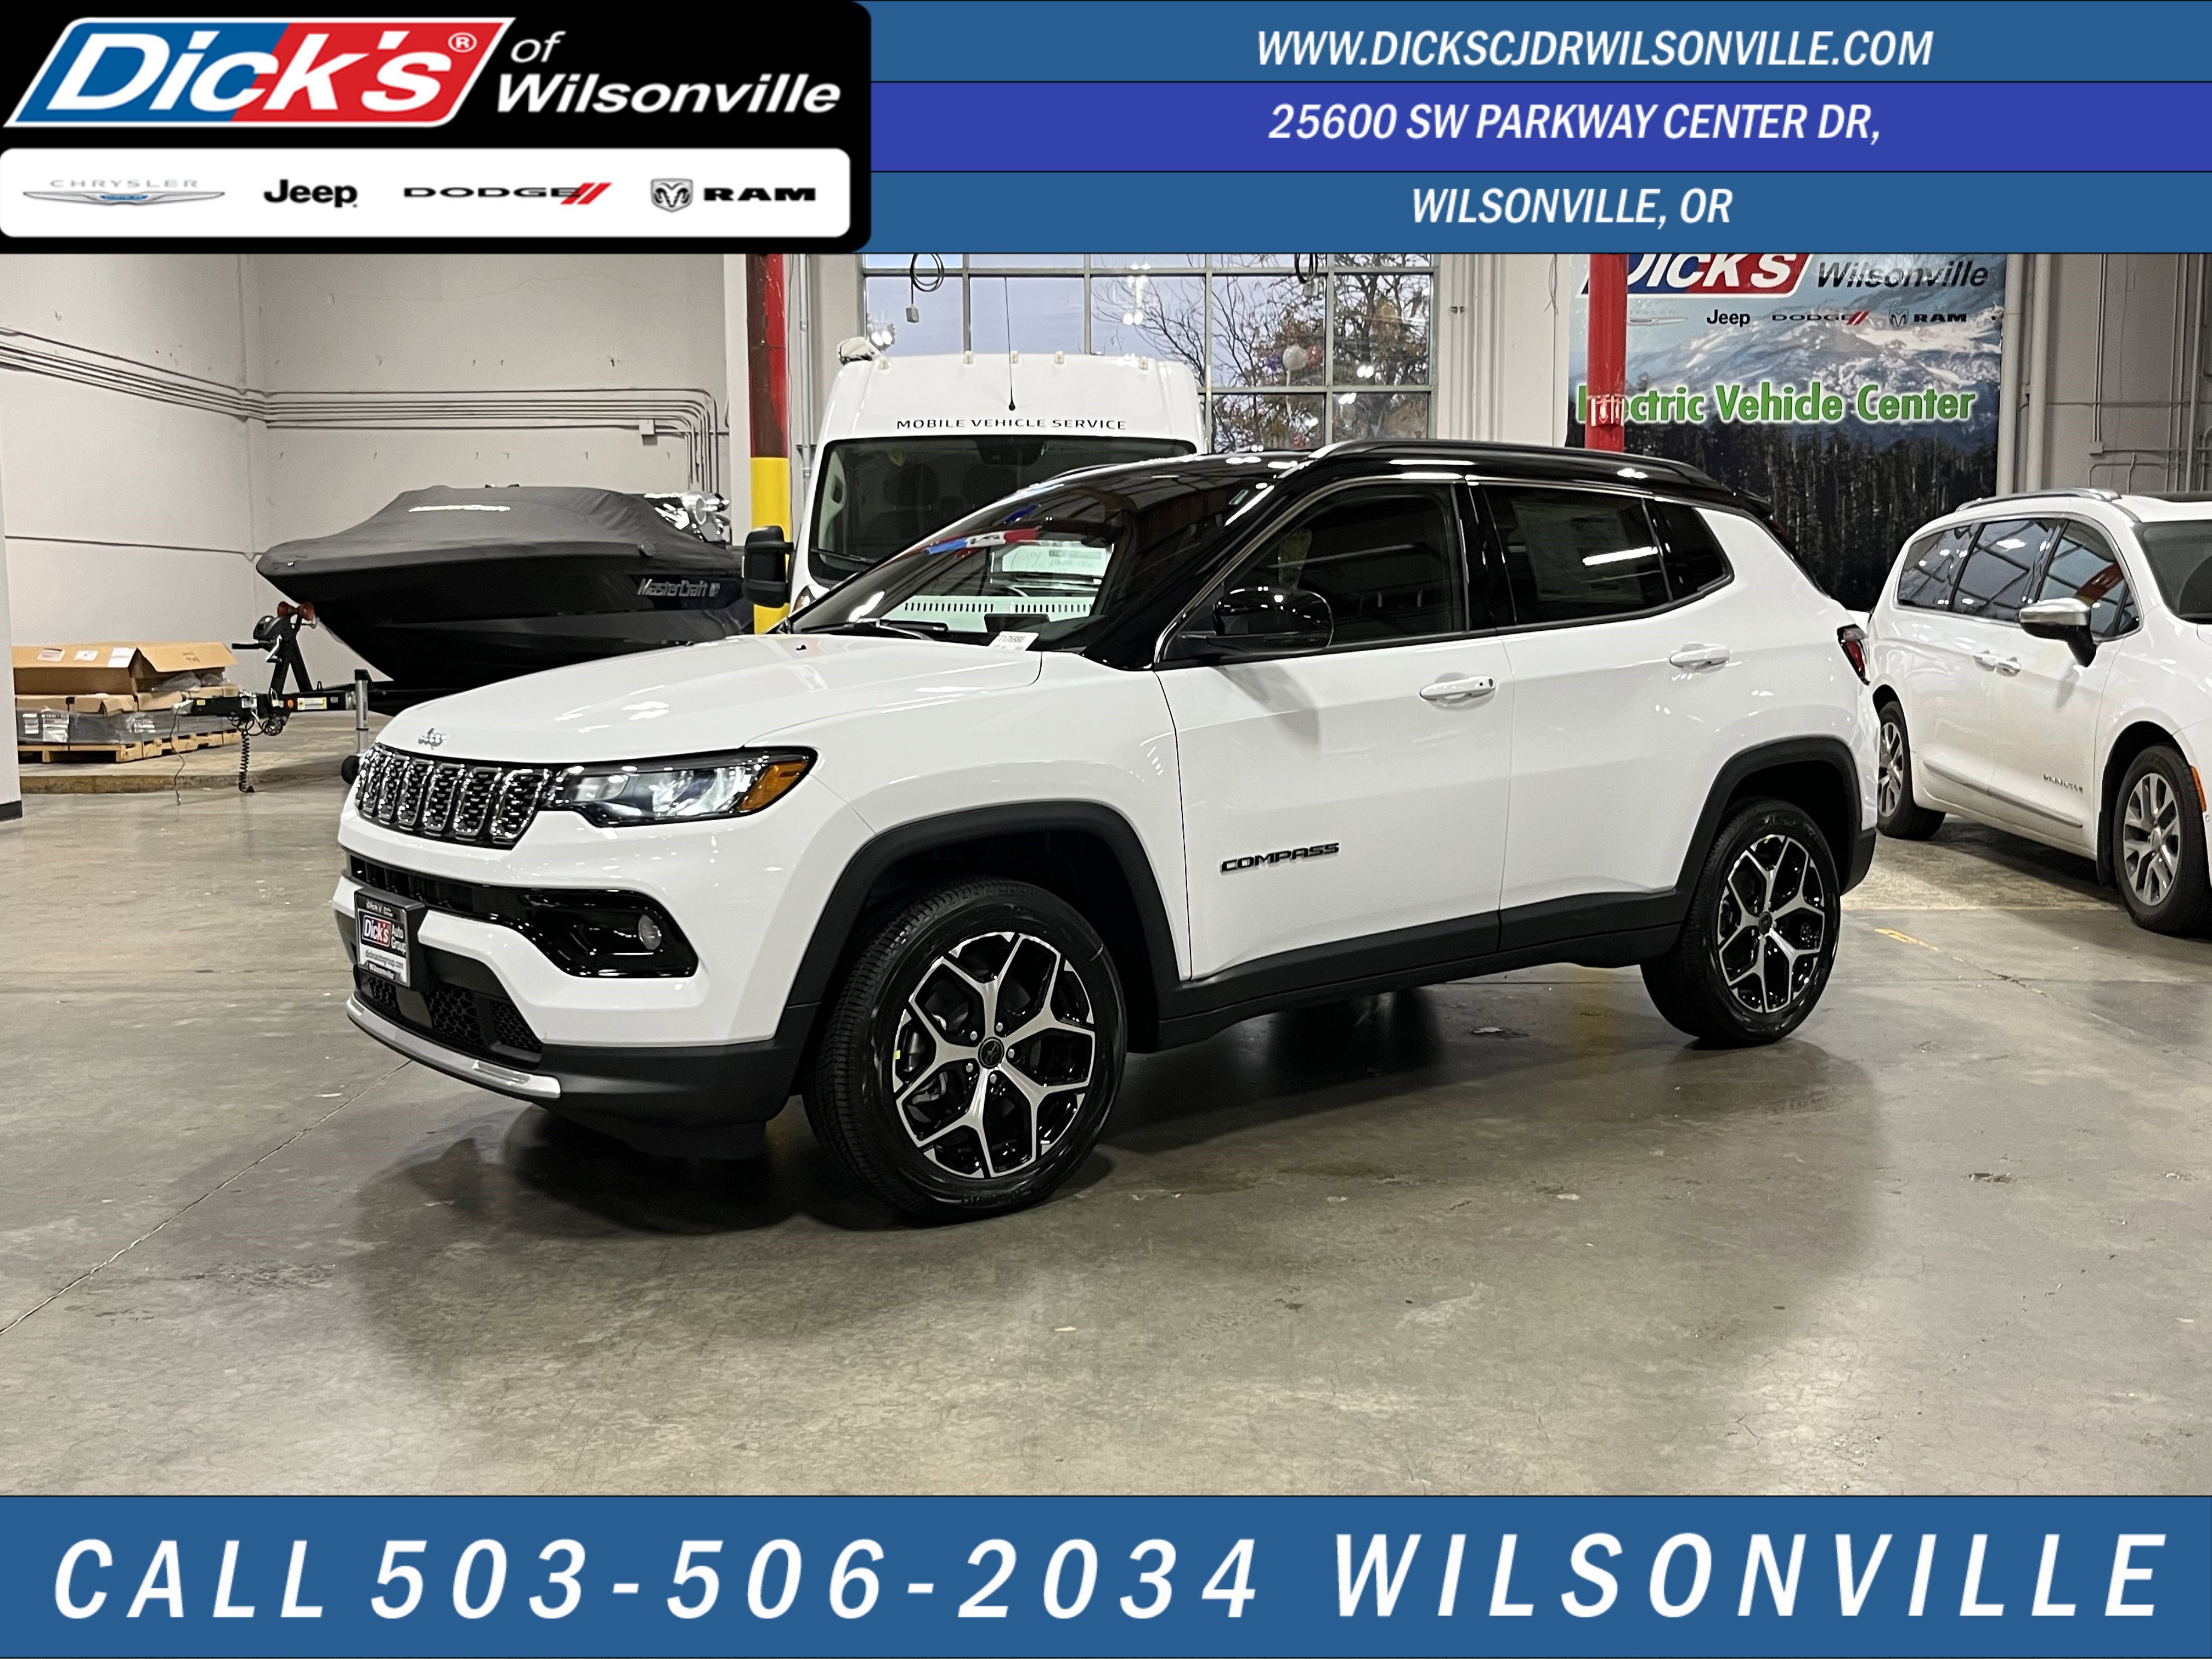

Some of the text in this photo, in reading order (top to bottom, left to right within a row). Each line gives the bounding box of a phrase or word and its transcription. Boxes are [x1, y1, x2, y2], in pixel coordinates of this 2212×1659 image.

[1817, 261, 1989, 288] Wilsonville
[1706, 309, 1751, 327] Jeep
[1913, 313, 1967, 323] RAM
[1716, 382, 1843, 421] Vehicle
[1858, 385, 1976, 420] Center
[896, 419, 1126, 430] MOBILE VEHICLE SERVICE
[1221, 842, 1339, 872] COMPASS
[364, 919, 390, 943] Dick's
